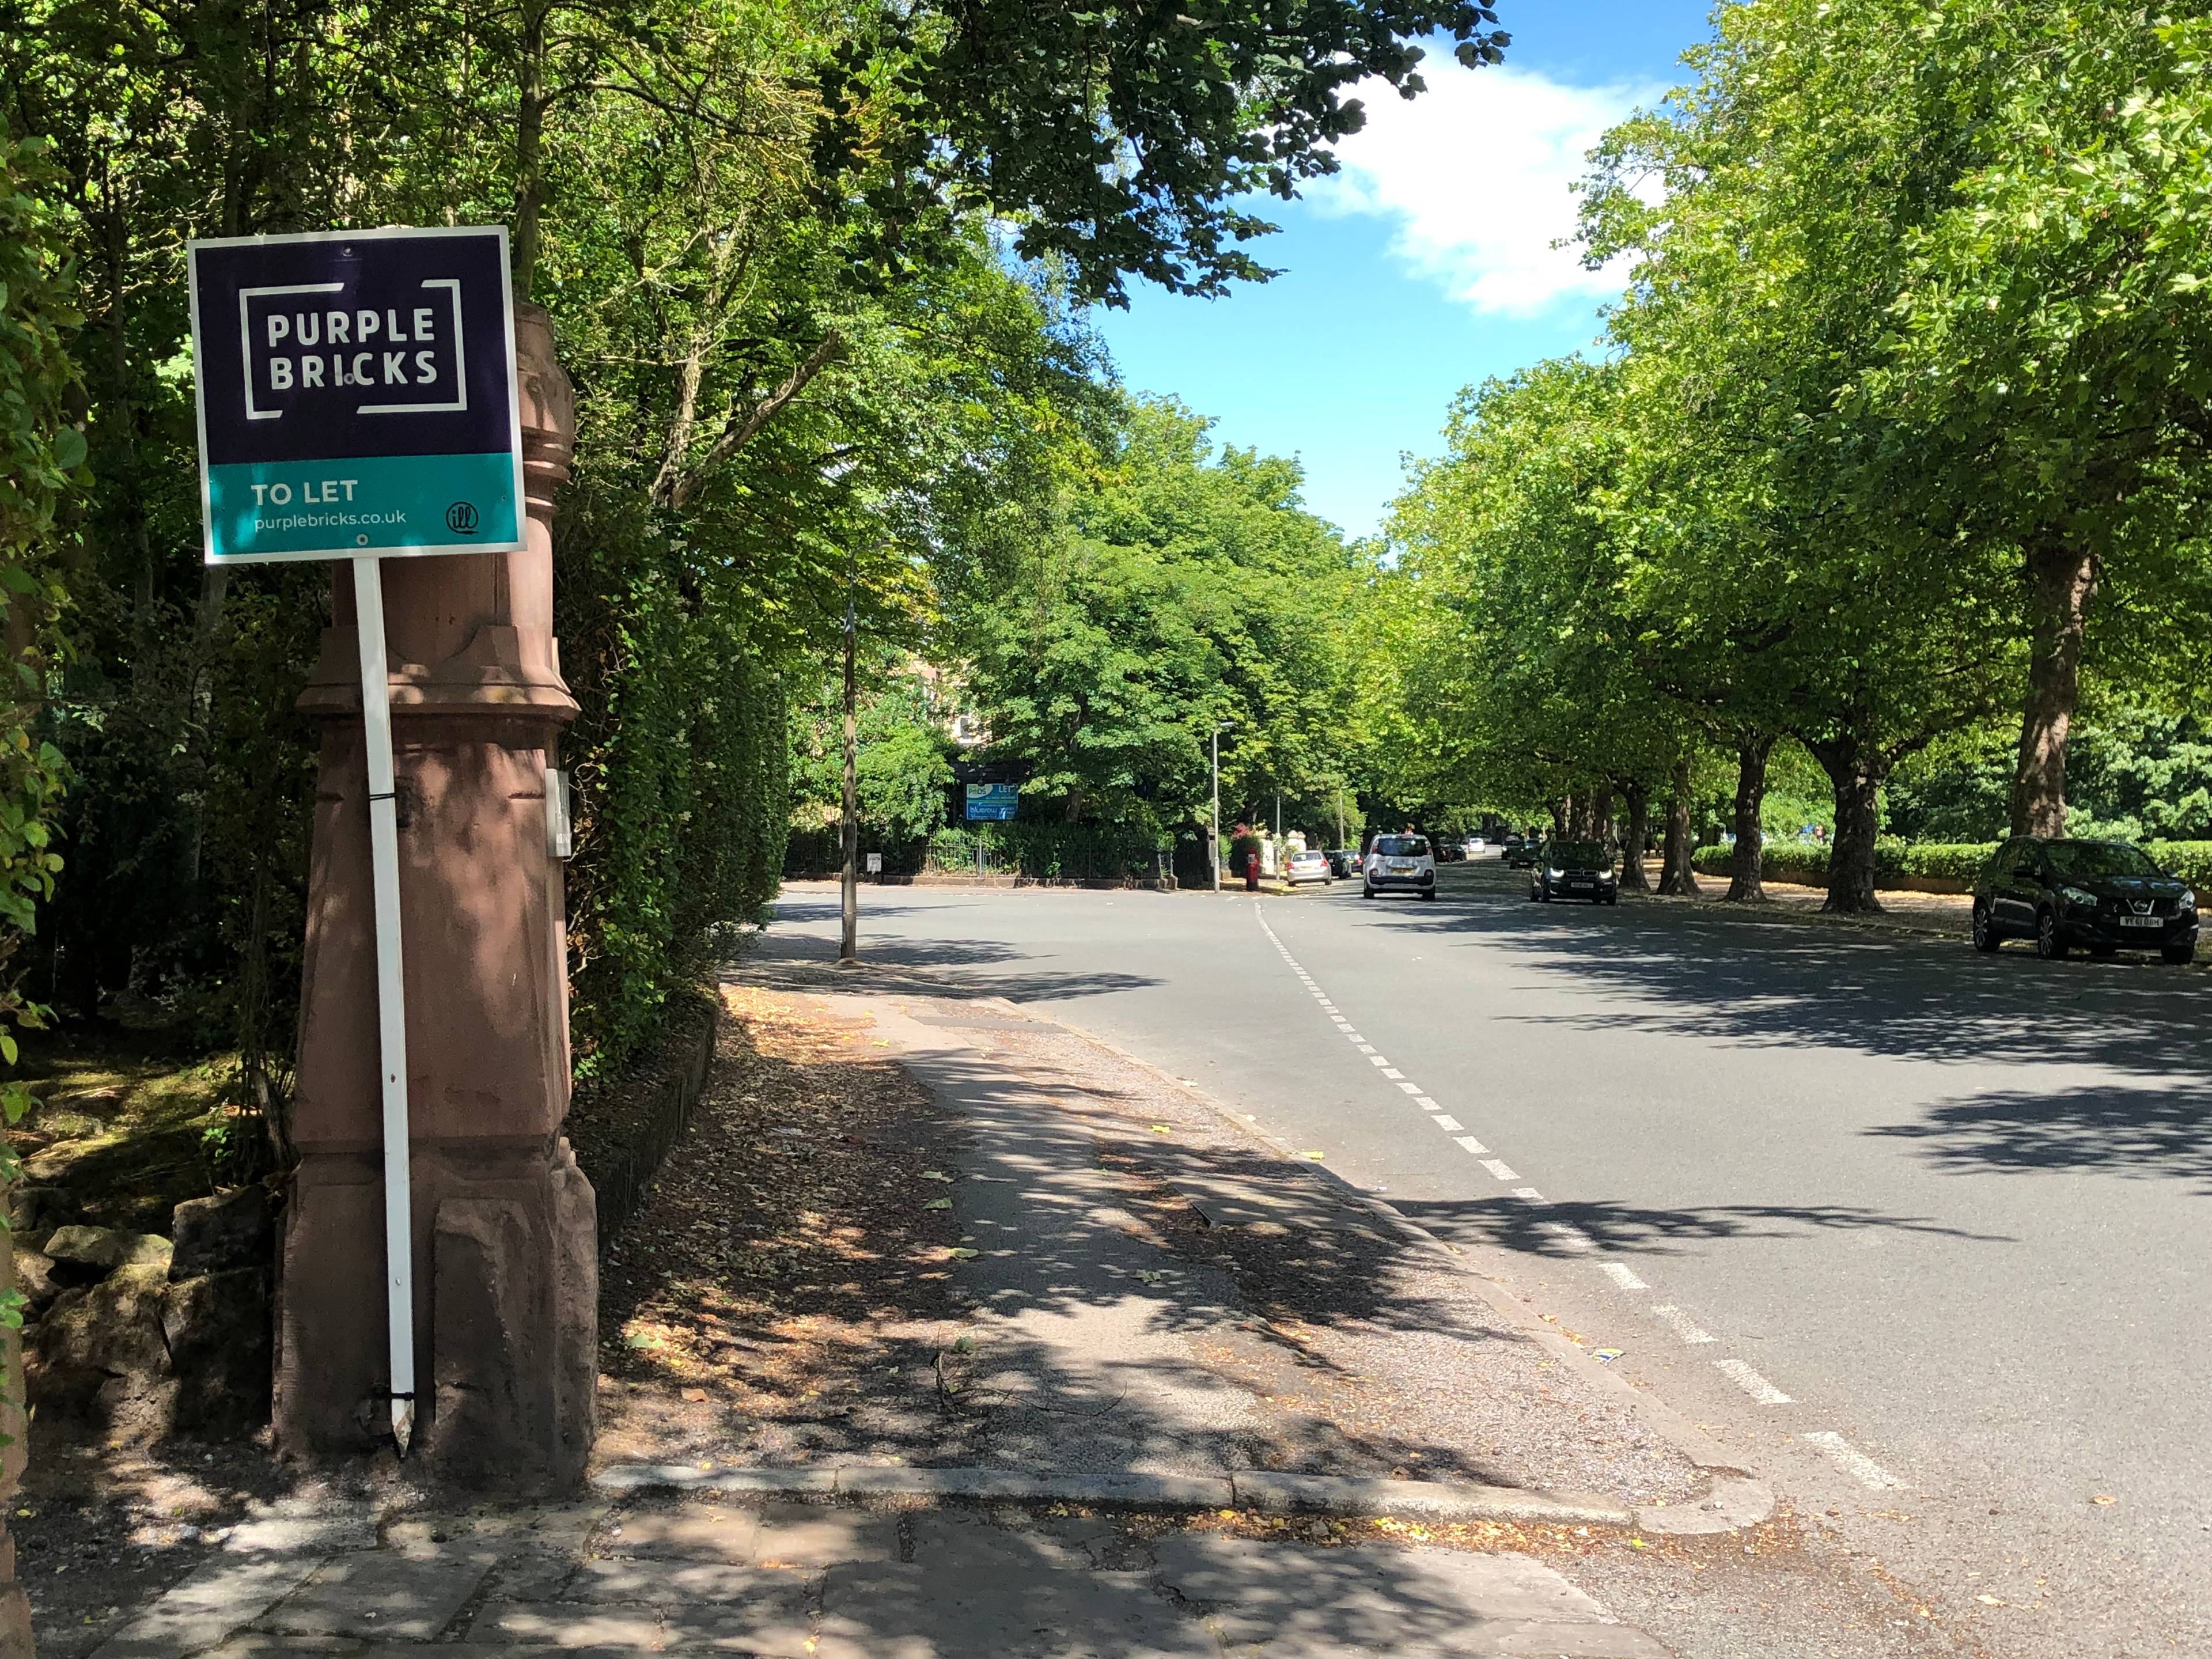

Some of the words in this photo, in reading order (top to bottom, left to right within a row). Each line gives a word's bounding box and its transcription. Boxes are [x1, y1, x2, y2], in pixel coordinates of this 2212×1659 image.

[267, 308, 435, 347] PURPLE
[270, 350, 437, 390] BRICKS
[251, 483, 291, 506] TO
[304, 479, 358, 503] LET
[255, 510, 406, 532] purplebricks.co.uk
